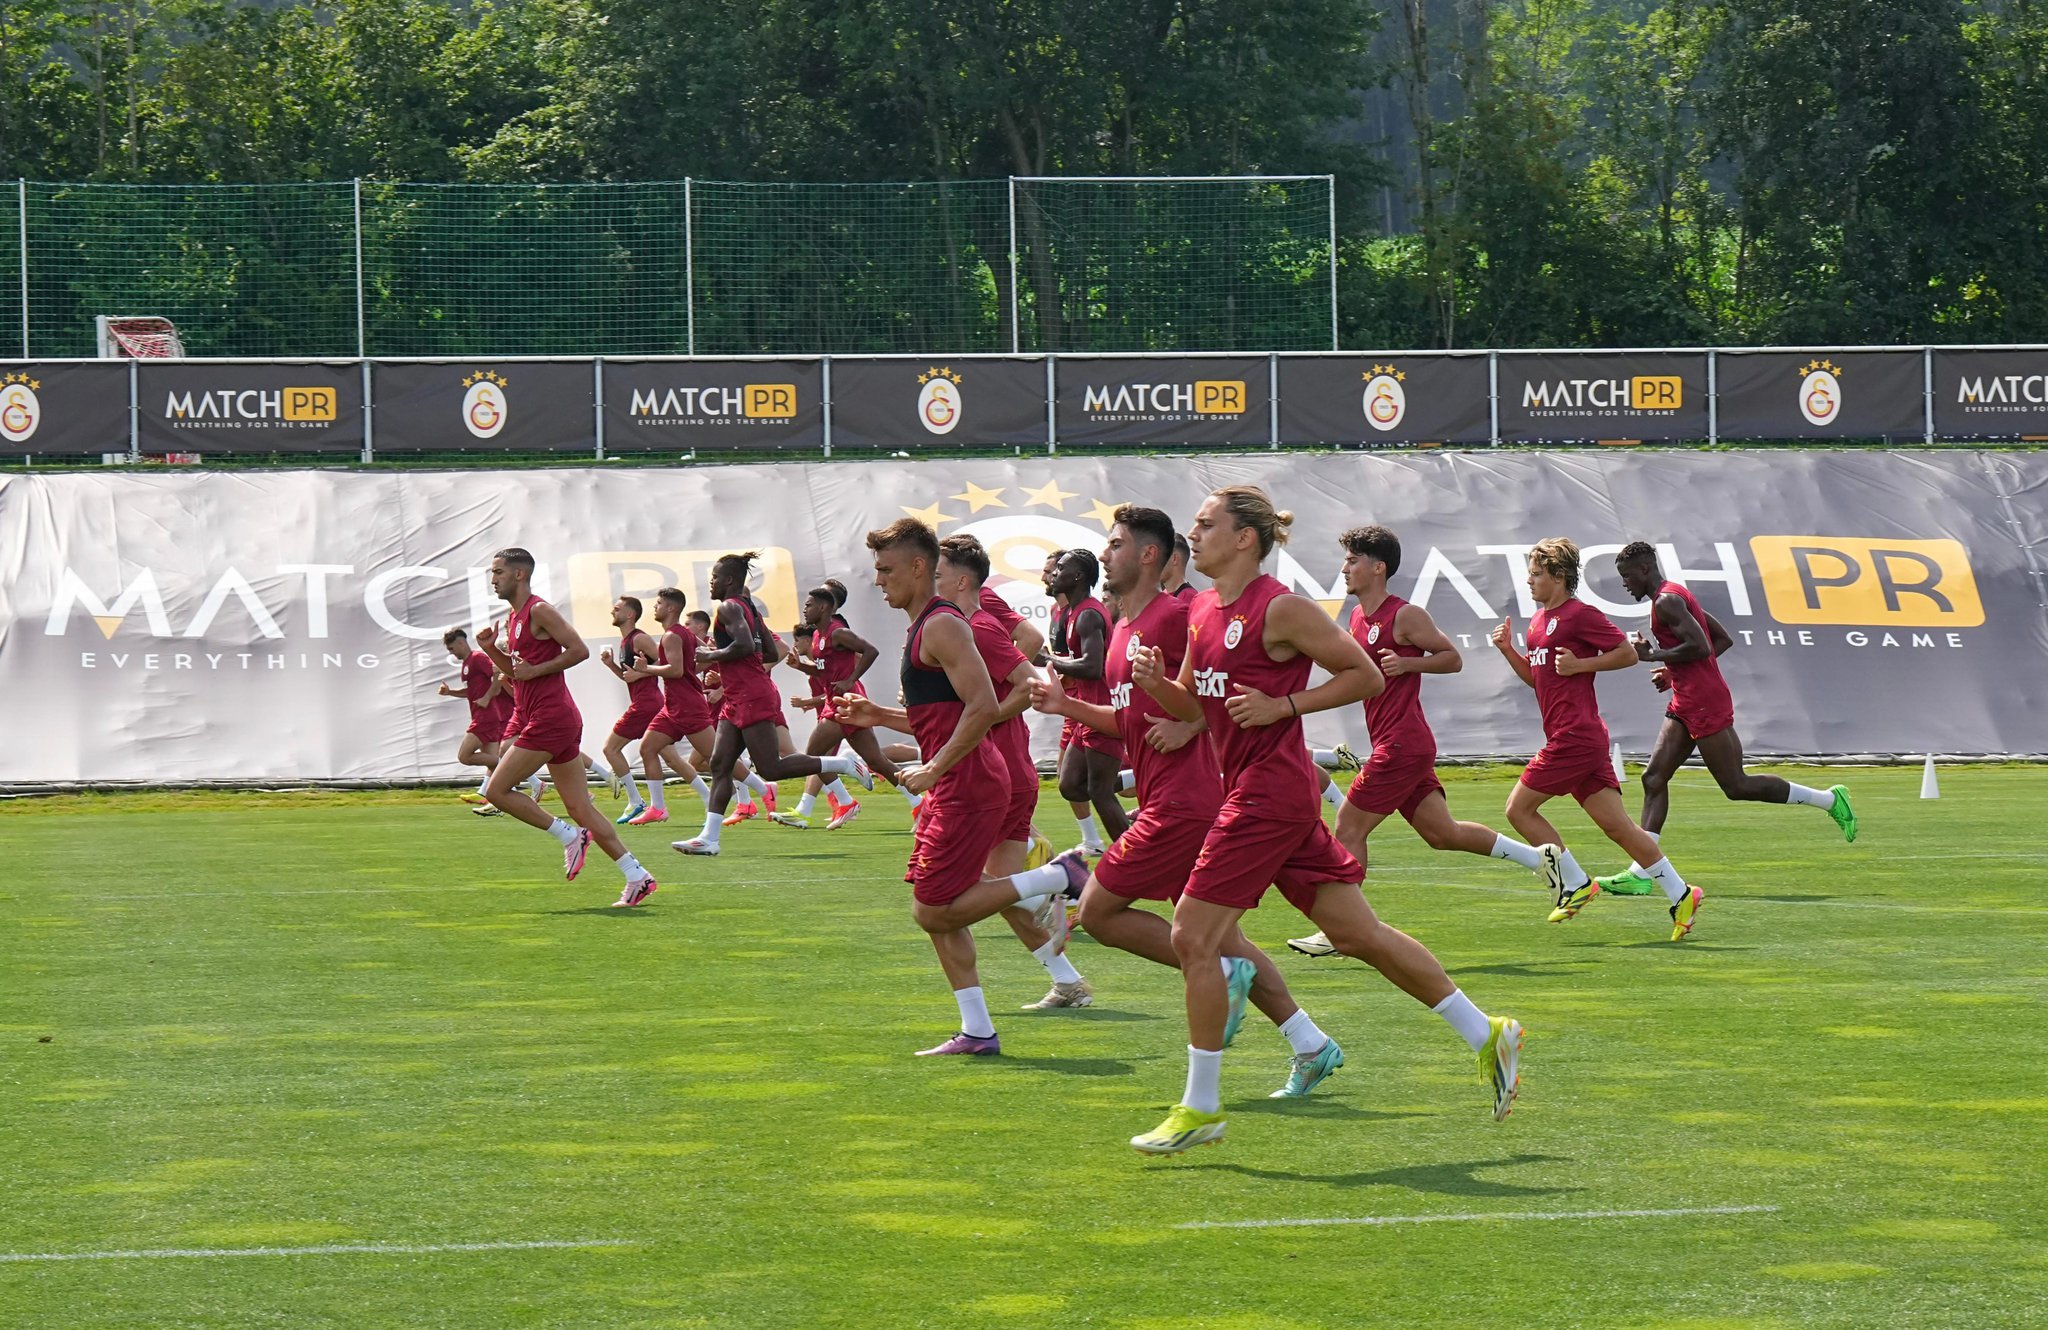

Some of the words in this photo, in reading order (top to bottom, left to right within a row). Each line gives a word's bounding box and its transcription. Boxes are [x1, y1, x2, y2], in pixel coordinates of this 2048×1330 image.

[630, 387, 743, 416] MATCH
[1083, 383, 1193, 412] MATCH
[1522, 379, 1630, 407] MATCH
[1957, 375, 2048, 403] MATC
[166, 390, 281, 418] MATCH
[1090, 414, 1156, 422] EVERYTHING
[173, 421, 242, 429] EVERYTHING
[247, 421, 269, 429] FOR
[637, 418, 705, 426] EVERYTHING
[1790, 546, 1955, 613] PR
[1739, 630, 1815, 646] THE
[1846, 631, 1964, 648] GAME
[81, 652, 381, 669] EVERYTHING
